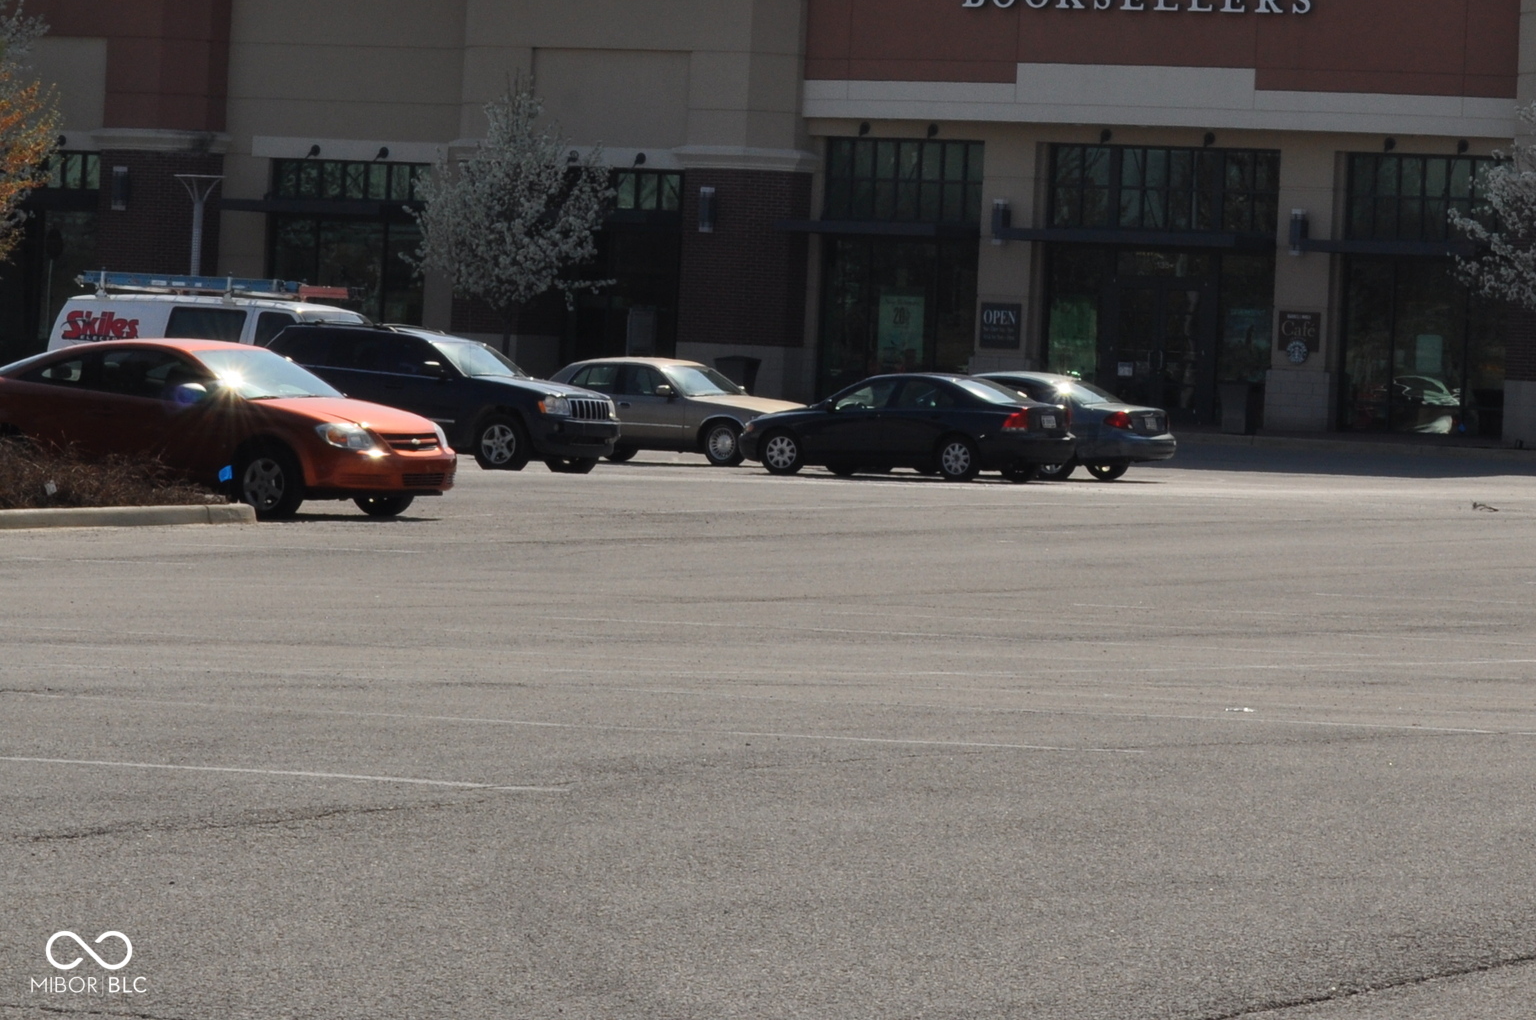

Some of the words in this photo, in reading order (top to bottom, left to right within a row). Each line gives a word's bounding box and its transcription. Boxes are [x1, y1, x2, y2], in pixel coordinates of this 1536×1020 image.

[61, 310, 139, 339] Skiles
[983, 309, 1017, 325] OPEN
[1281, 320, 1316, 338] Café
